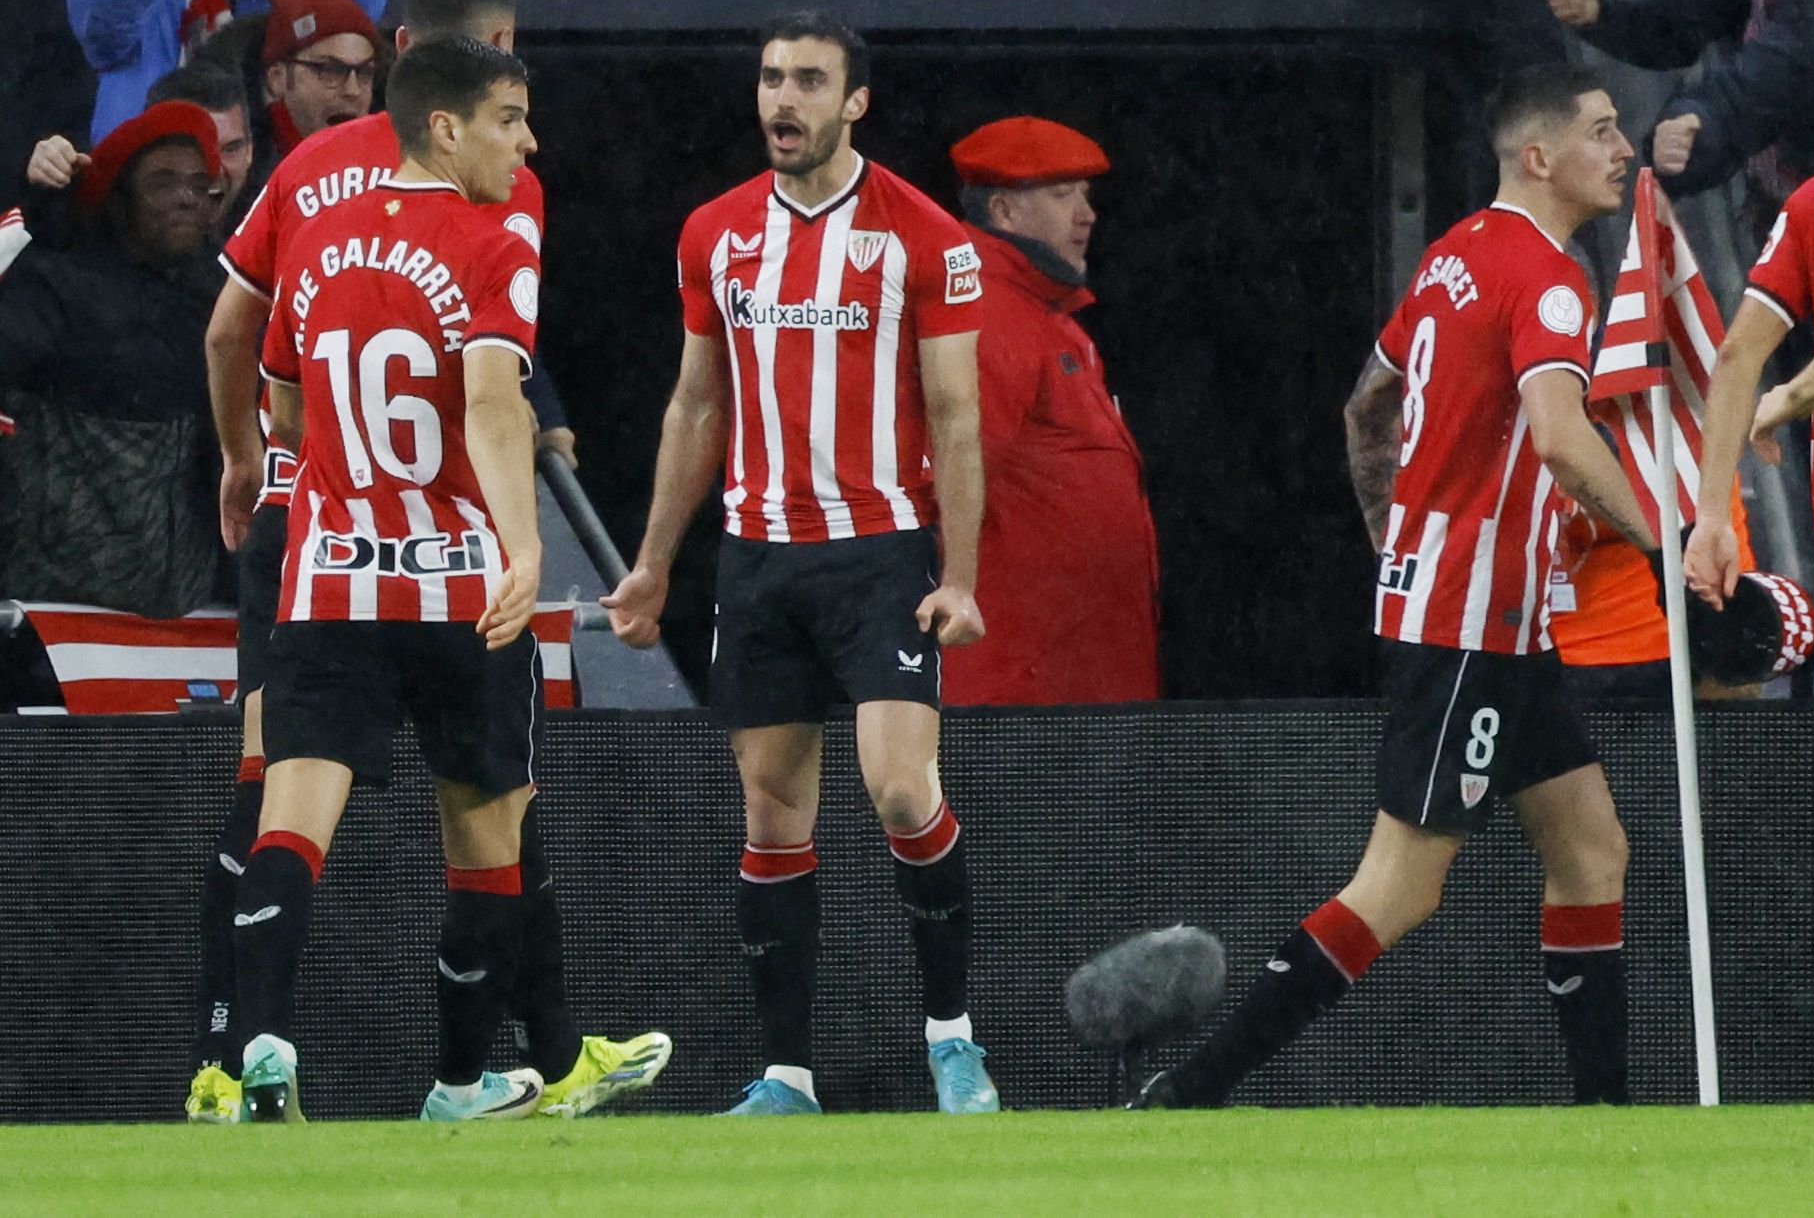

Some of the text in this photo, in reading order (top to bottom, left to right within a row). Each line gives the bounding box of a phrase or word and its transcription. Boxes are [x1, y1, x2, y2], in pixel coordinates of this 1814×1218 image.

[320, 237, 472, 353] GALARRETA
[311, 328, 444, 490] 16
[1401, 315, 1436, 468] 8
[311, 534, 487, 575] DIGI
[1465, 706, 1500, 770] 8
